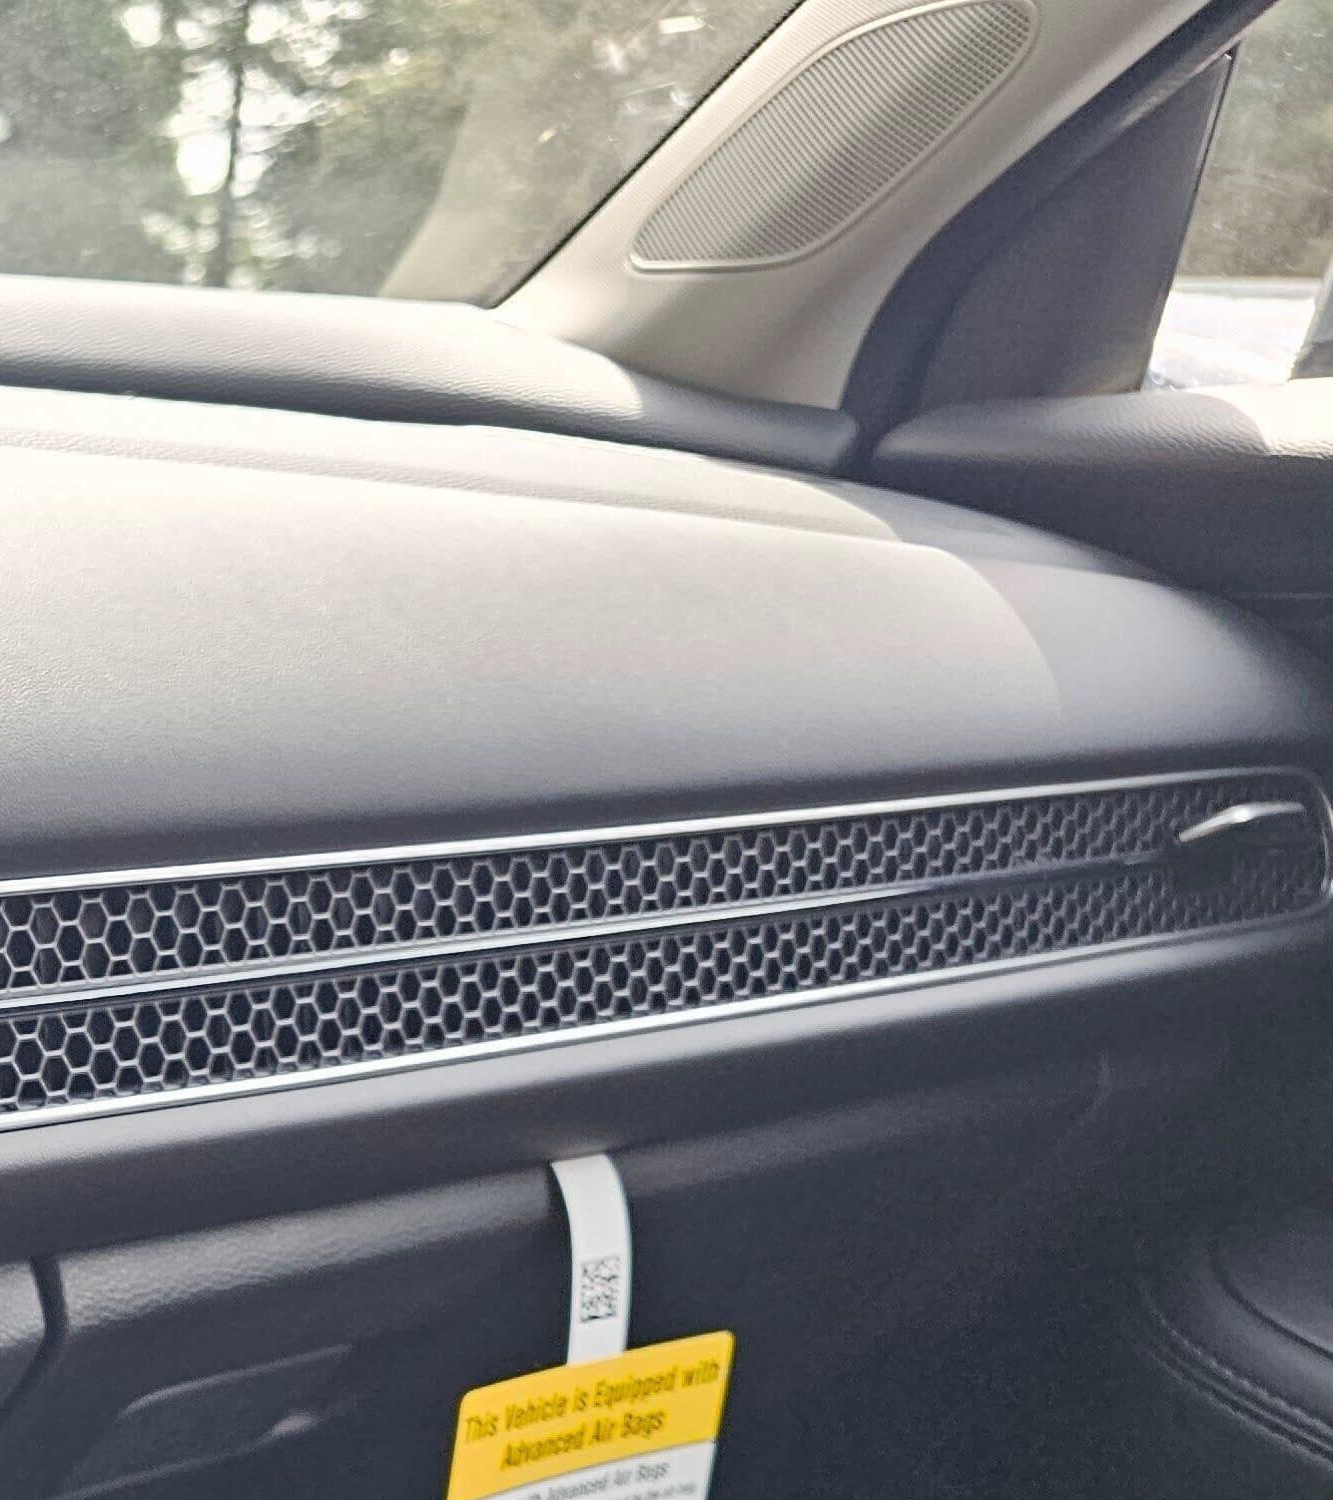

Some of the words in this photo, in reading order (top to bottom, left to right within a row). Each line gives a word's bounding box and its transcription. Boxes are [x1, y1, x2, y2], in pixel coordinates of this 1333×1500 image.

[464, 1412, 499, 1444] This
[504, 1393, 568, 1432] Vehicle
[571, 1386, 589, 1413] is
[593, 1364, 678, 1410] Equipped
[681, 1358, 720, 1387] with
[500, 1421, 587, 1471] Advanced
[590, 1416, 617, 1446] Air
[620, 1408, 668, 1441] Bags
